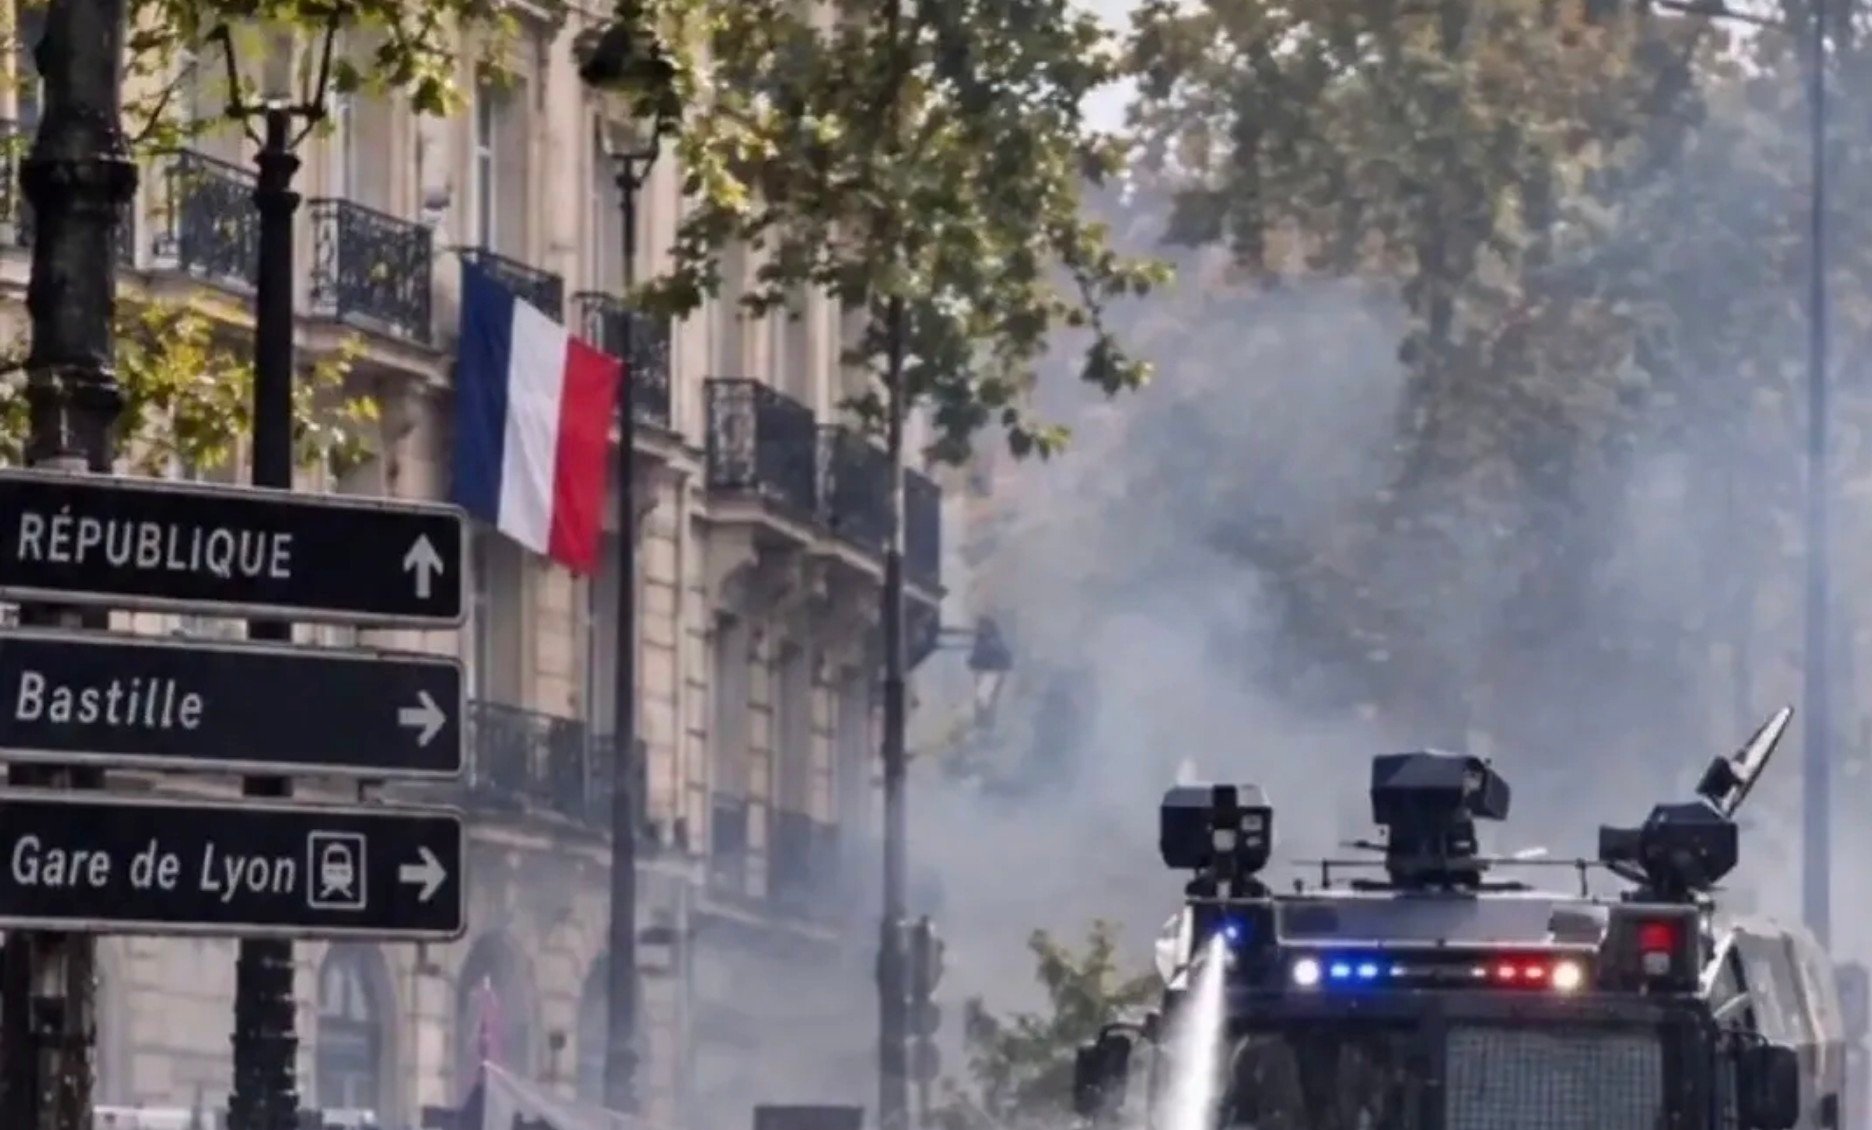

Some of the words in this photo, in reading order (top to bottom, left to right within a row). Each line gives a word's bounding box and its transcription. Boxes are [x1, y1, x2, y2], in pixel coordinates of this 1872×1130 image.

[18, 504, 293, 578] RÉPUBLIQUE
[15, 671, 203, 729] Bastille
[12, 835, 110, 887] Gare
[130, 839, 180, 890] de
[200, 843, 295, 902] Lyon
